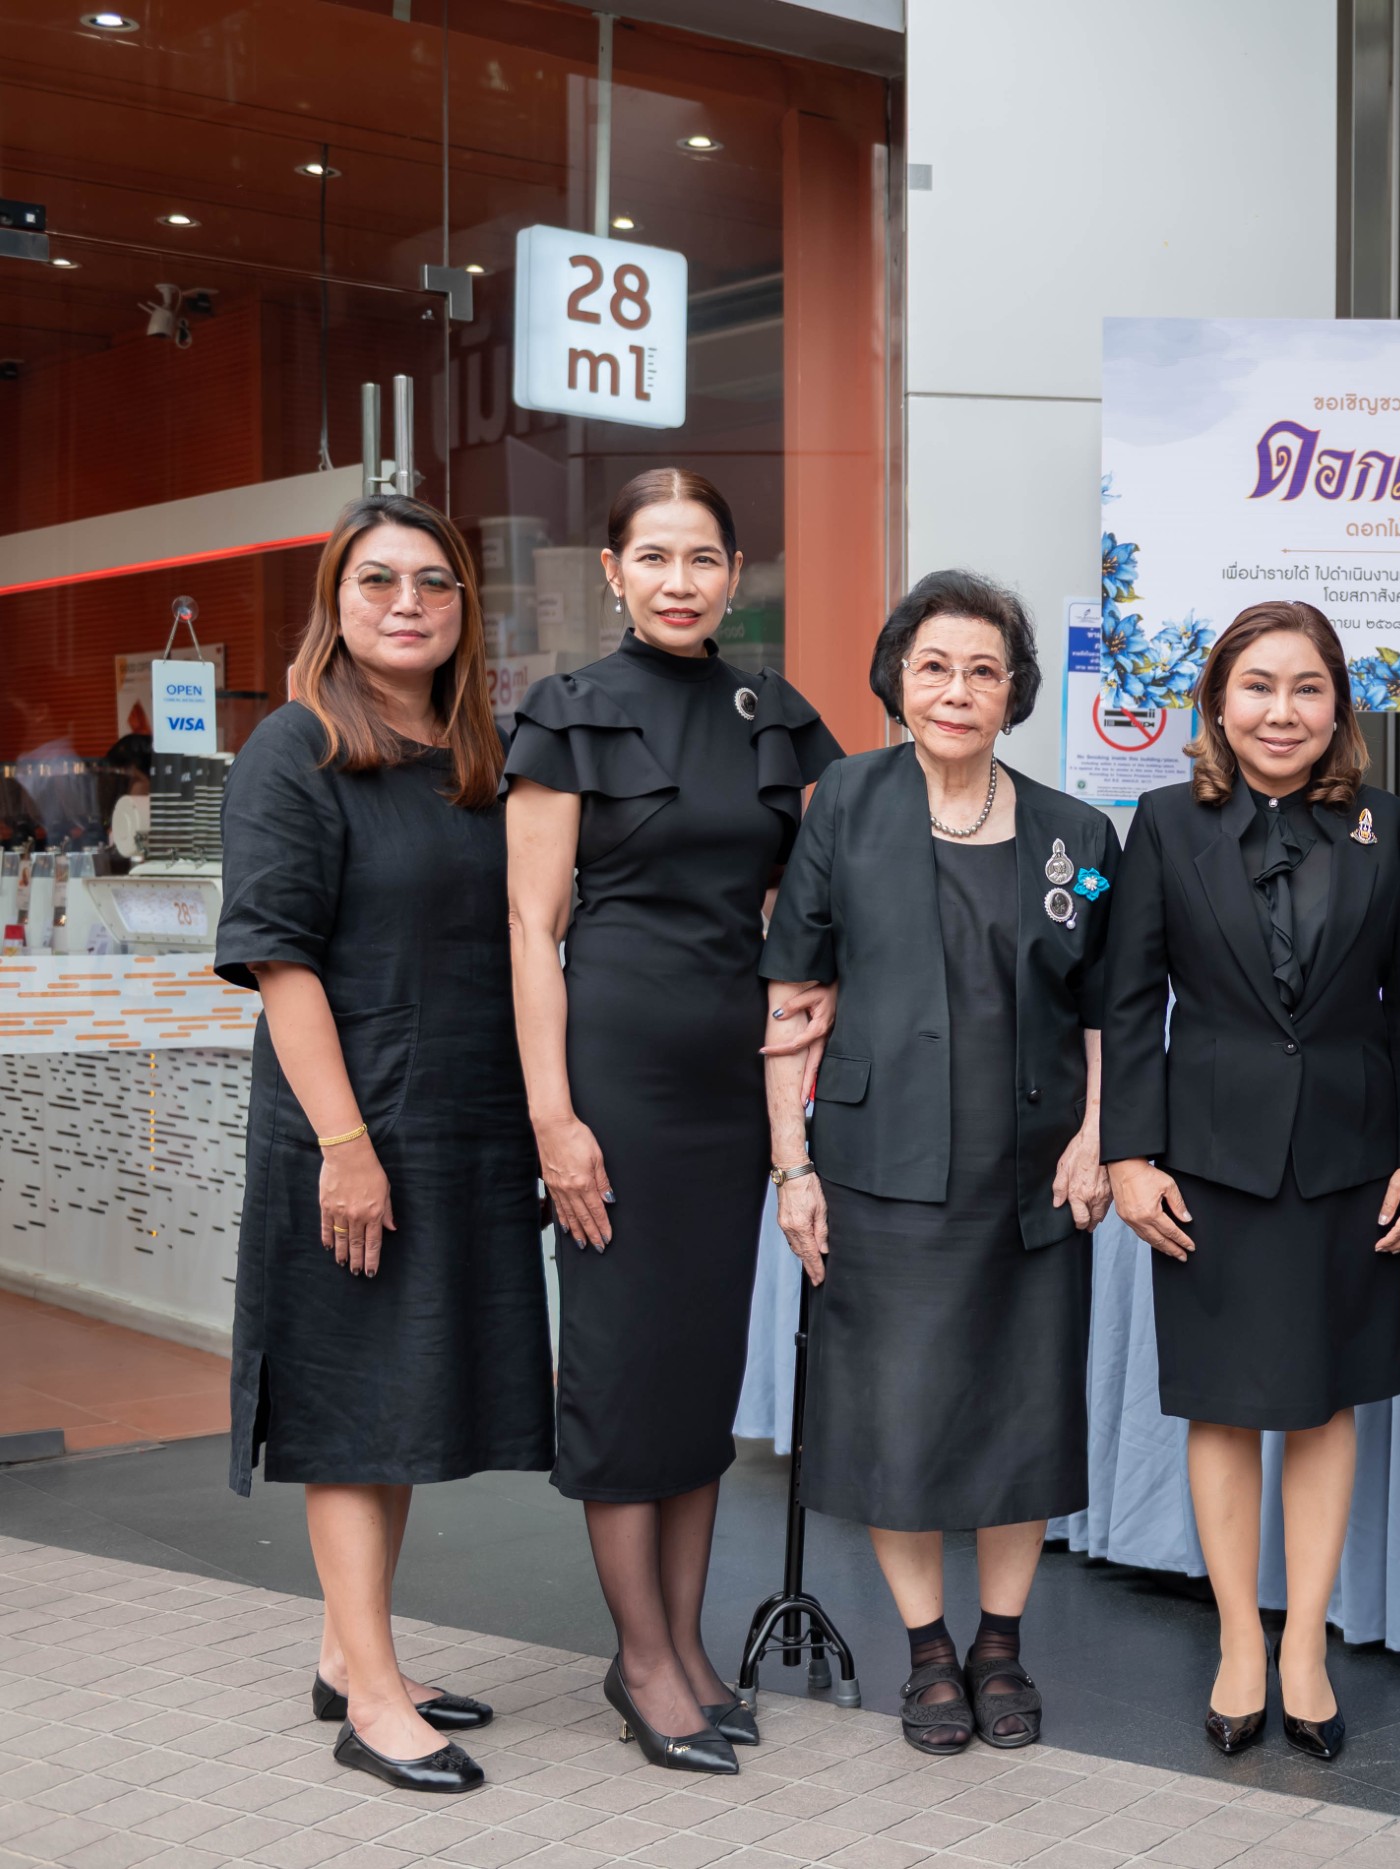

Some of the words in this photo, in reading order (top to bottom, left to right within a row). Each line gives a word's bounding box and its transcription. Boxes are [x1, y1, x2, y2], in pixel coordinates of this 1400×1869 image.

[567, 254, 652, 331] 28
[567, 344, 652, 402] ml
[1222, 562, 1309, 581] เพื่อนำรายได้
[166, 684, 203, 697] OPEN
[167, 716, 206, 731] VISA
